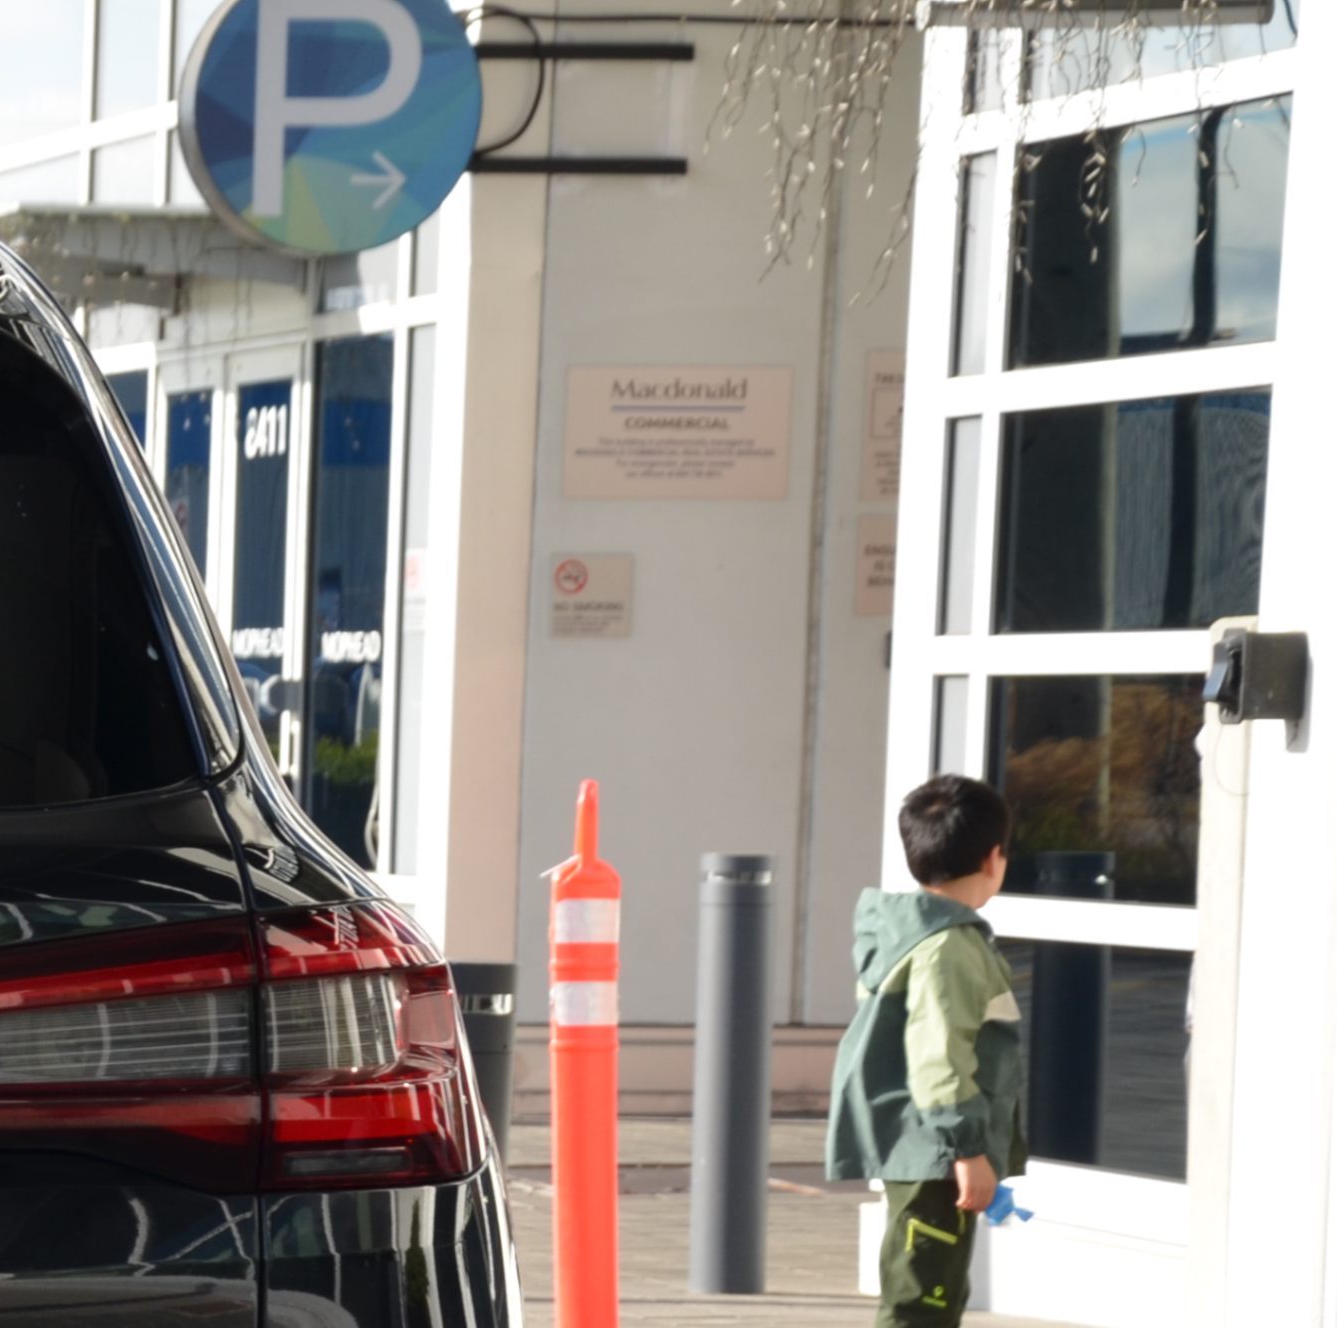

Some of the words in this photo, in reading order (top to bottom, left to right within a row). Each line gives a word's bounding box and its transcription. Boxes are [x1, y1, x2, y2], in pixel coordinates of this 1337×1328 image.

[252, 0, 422, 216] P
[611, 378, 747, 399] Macdonald
[625, 417, 730, 430] COMMERCIAL
